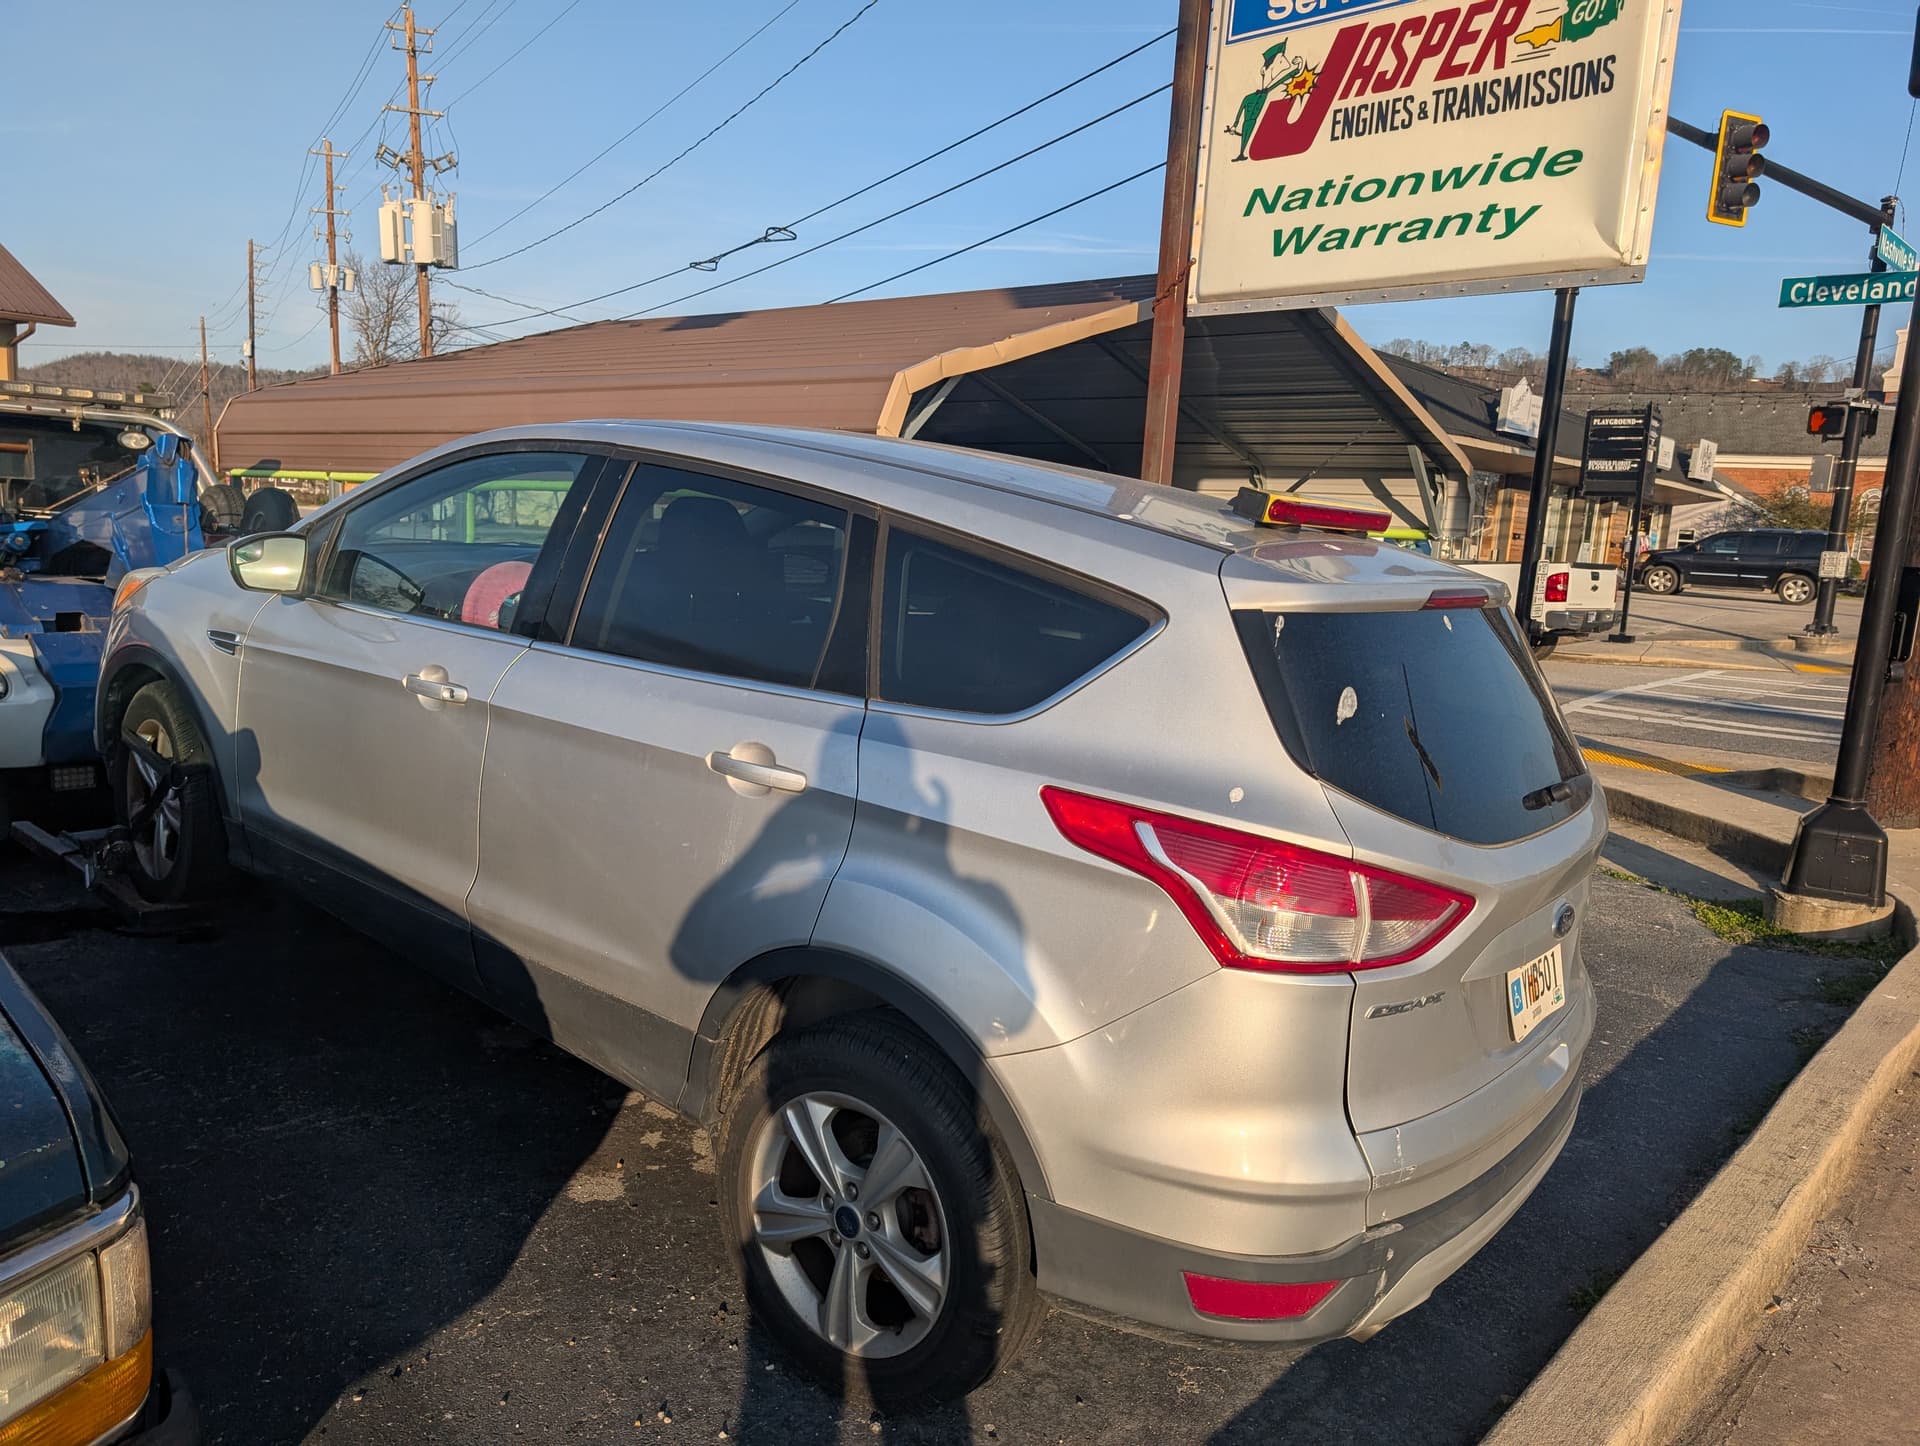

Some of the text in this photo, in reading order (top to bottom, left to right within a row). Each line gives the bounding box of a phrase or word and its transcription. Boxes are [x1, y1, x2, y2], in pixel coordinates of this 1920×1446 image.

[1249, 0, 1531, 161] JASPER
[1330, 55, 1617, 141] ENGINES & TRANSMISSIONS
[1243, 146, 1584, 217] Nationwide
[1271, 203, 1543, 257] Warranty
[1790, 276, 1918, 304] Cleveland
[1593, 418, 1636, 426] PLAYGROUND
